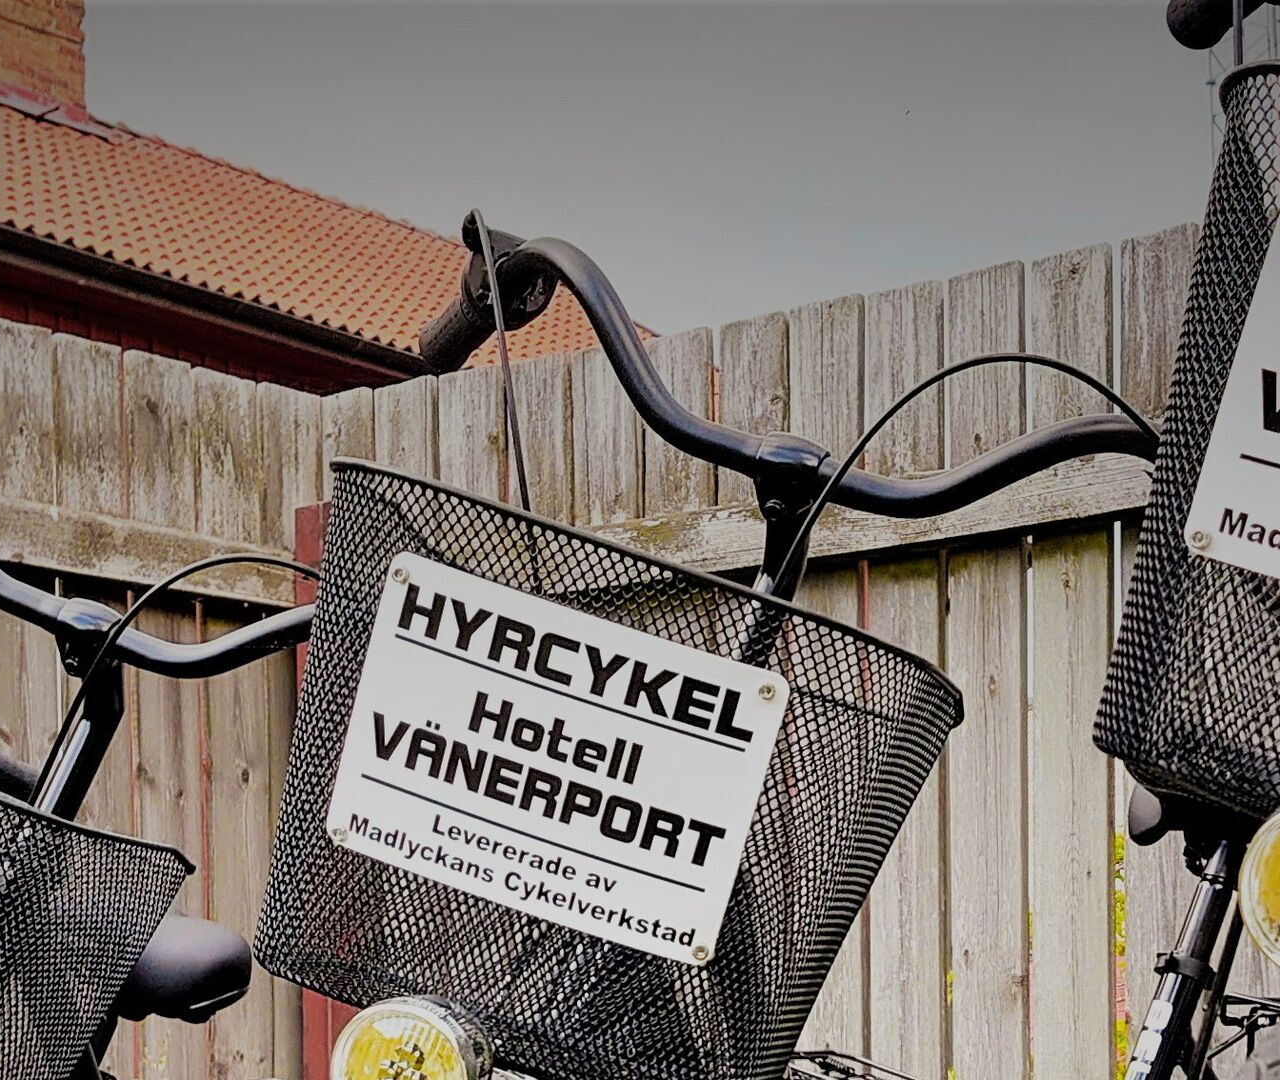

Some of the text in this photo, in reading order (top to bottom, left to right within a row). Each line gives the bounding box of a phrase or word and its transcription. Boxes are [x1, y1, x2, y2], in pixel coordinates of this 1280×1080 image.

[398, 583, 754, 742] HYRCYKEL
[373, 712, 726, 866] VÄNERPORT
[468, 691, 643, 784] Hotell
[350, 814, 695, 947] Madlyckans Cykelverkstad
[432, 815, 616, 892] Levererade av
